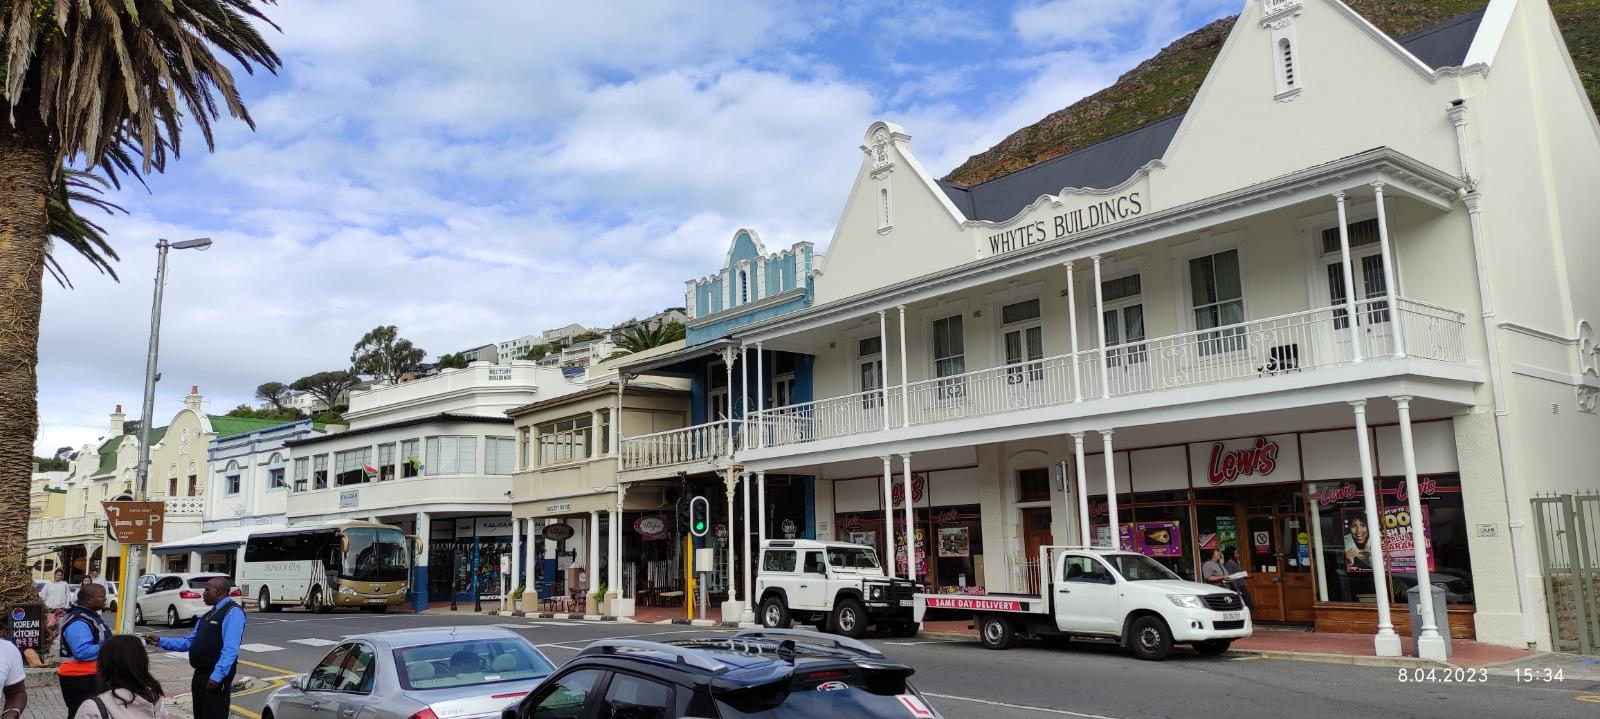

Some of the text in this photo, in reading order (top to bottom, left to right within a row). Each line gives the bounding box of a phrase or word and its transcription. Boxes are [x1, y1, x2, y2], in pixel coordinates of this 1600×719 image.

[988, 191, 1142, 255] WHYTE'S BUILDINGS
[1208, 436, 1279, 485] Lewis
[150, 514, 161, 526] P
[935, 599, 1014, 610] SAME DAY DELIVERY
[13, 620, 40, 629] KOREAN
[903, 697, 928, 714] L
